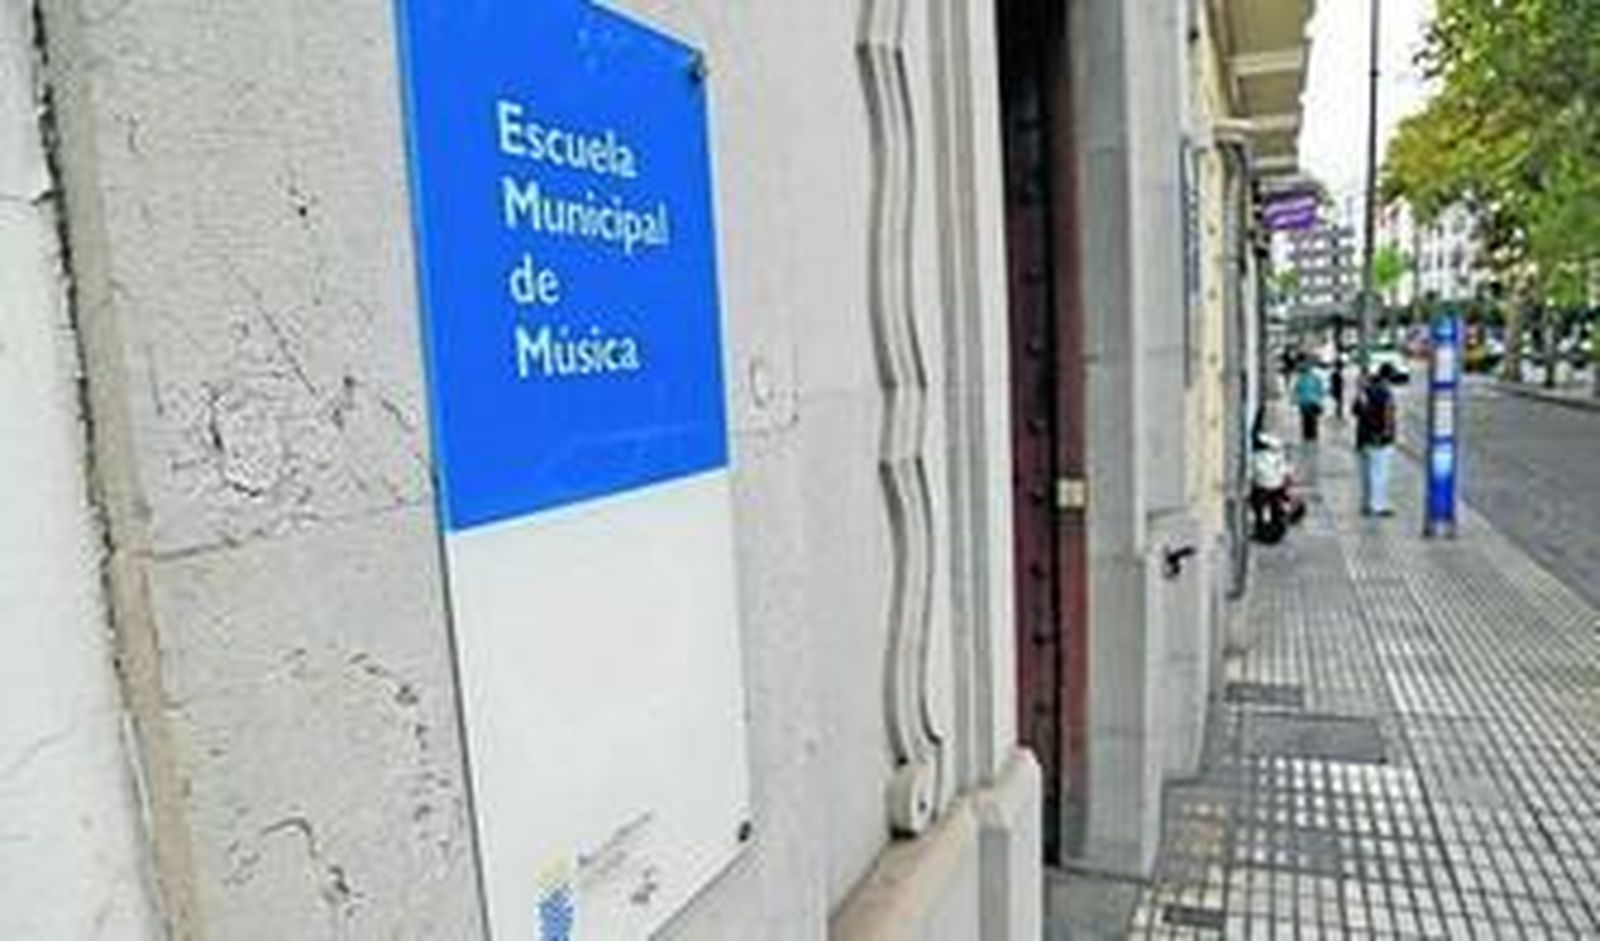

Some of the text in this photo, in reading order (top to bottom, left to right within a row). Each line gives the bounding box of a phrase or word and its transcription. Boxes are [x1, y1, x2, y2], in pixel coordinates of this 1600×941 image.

[497, 100, 636, 178] Escuela
[503, 176, 669, 252] Municipal
[510, 253, 560, 303] de
[515, 324, 640, 378] Música
